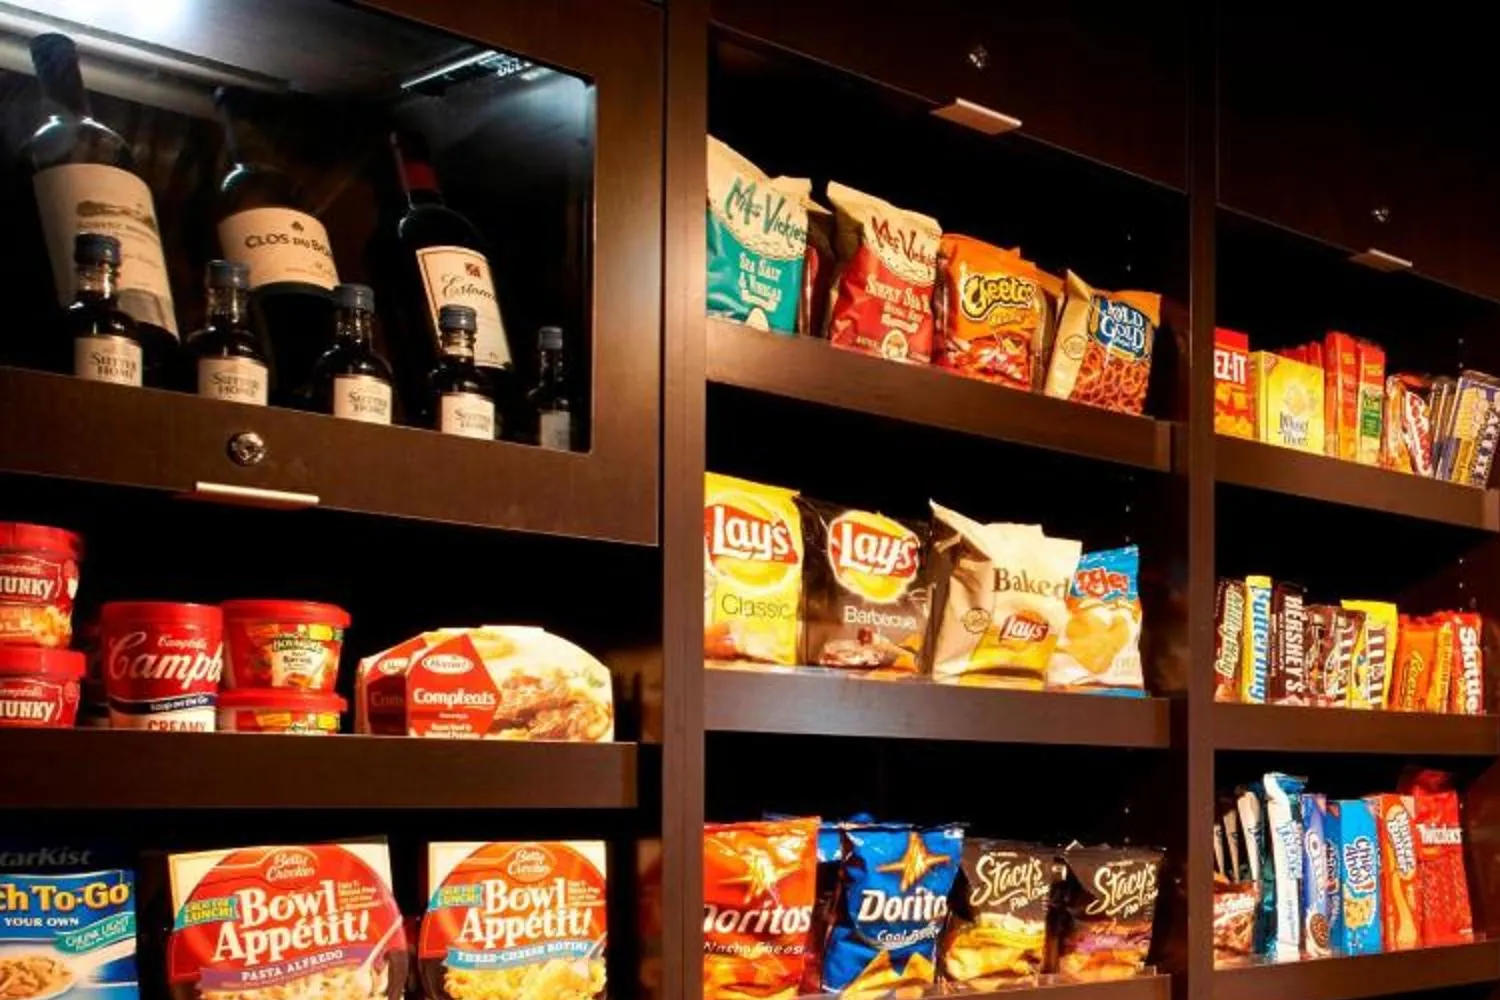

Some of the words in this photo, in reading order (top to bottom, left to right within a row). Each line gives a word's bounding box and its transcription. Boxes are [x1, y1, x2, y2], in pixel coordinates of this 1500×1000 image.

[244, 233, 290, 249] CLOS
[991, 567, 1072, 601] Baked
[721, 593, 792, 620] Classic
[843, 604, 918, 630] Barbecue
[412, 687, 496, 708] Compleats
[480, 876, 567, 915] Bowl
[969, 854, 1043, 907] Stacy's
[1085, 862, 1157, 916] Stacy's
[235, 880, 340, 928] Bowl
[856, 886, 948, 923] Dorito
[4, 917, 43, 928] YOUR
[45, 916, 80, 927] OWN
[240, 963, 284, 983] PASTA
[285, 949, 345, 974] ALFREDO
